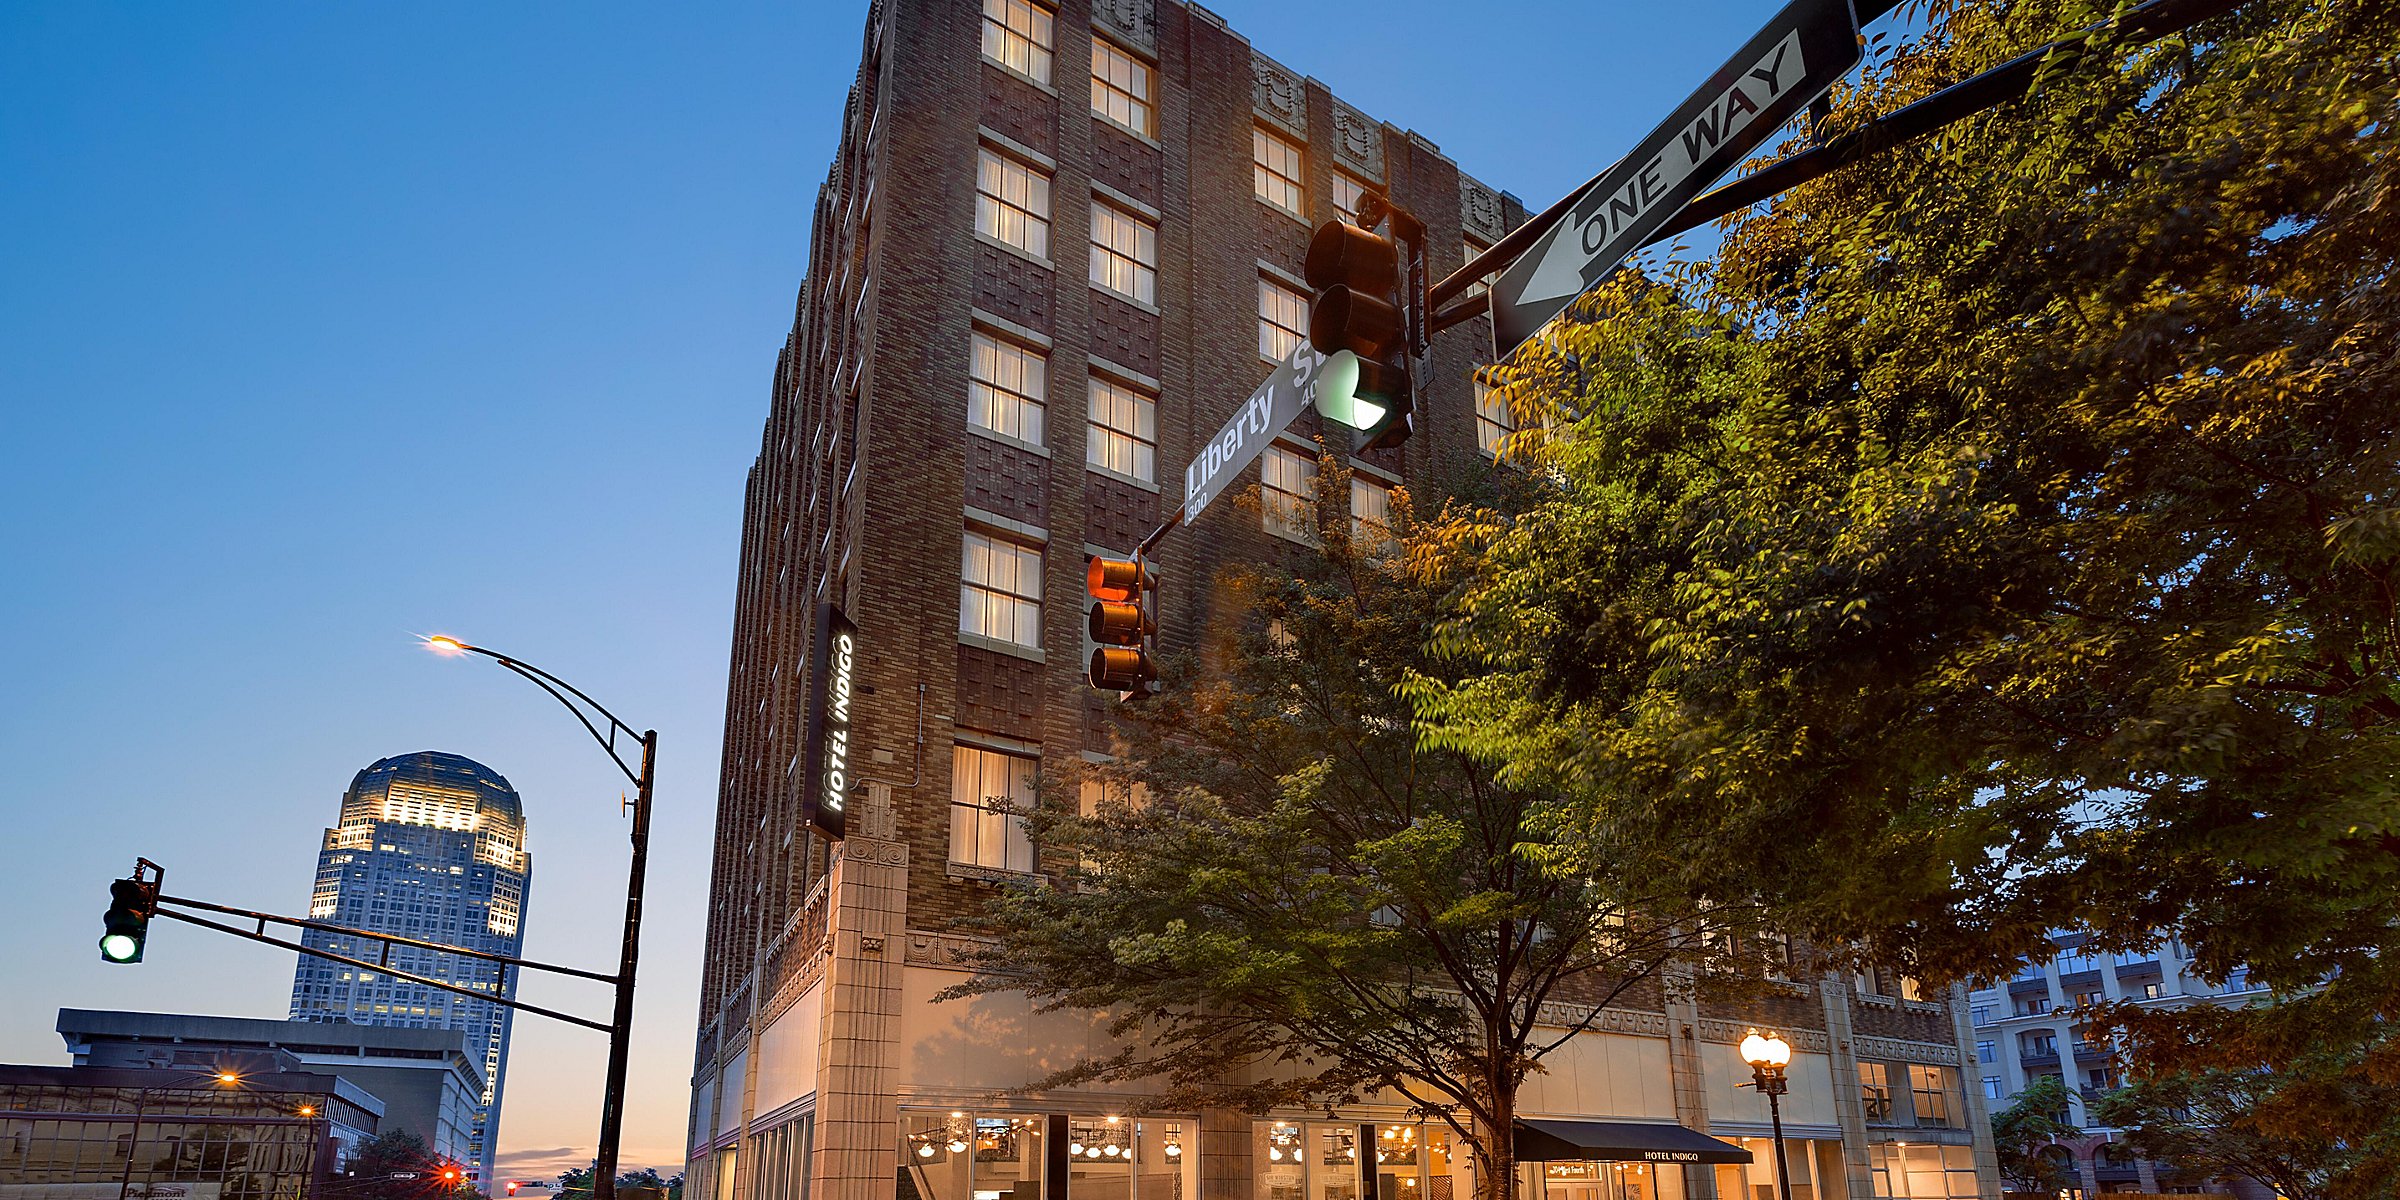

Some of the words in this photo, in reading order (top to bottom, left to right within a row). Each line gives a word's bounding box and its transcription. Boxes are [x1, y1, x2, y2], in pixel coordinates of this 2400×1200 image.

[1581, 155, 1668, 256] ONE
[1681, 40, 1790, 166] WAY
[1188, 384, 1275, 500] Liberty
[1188, 492, 1207, 521] 300
[834, 634, 853, 722] INDIGO
[829, 731, 847, 812] HOTEL
[1645, 1151, 1670, 1160] HOTEL
[1672, 1152, 1699, 1161] INDIGO
